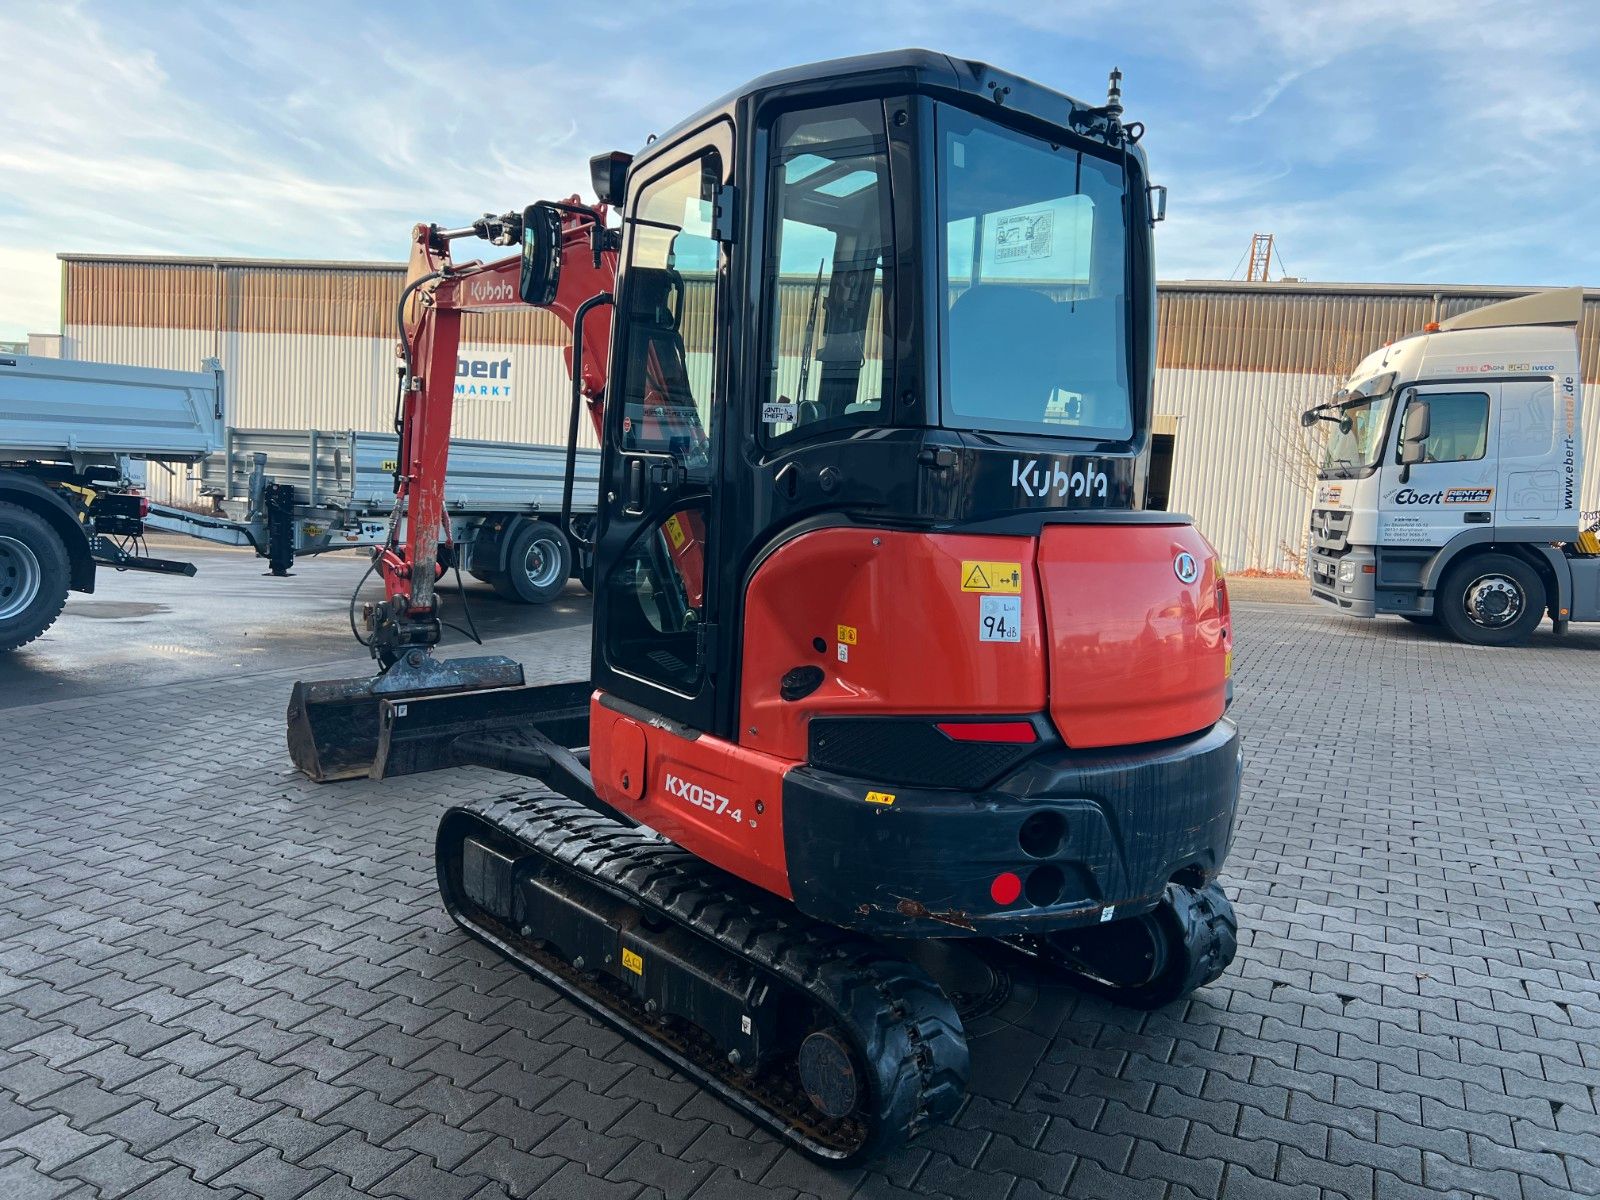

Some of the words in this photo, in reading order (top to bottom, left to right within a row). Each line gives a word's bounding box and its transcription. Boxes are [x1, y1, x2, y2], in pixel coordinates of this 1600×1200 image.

[471, 279, 513, 301] Kubota
[455, 355, 511, 379] bert
[1563, 376, 1574, 510] www.ebert-rental.de
[1011, 459, 1108, 497] Kubota
[1395, 488, 1443, 505] Ebert
[664, 773, 742, 823] KX037-4
